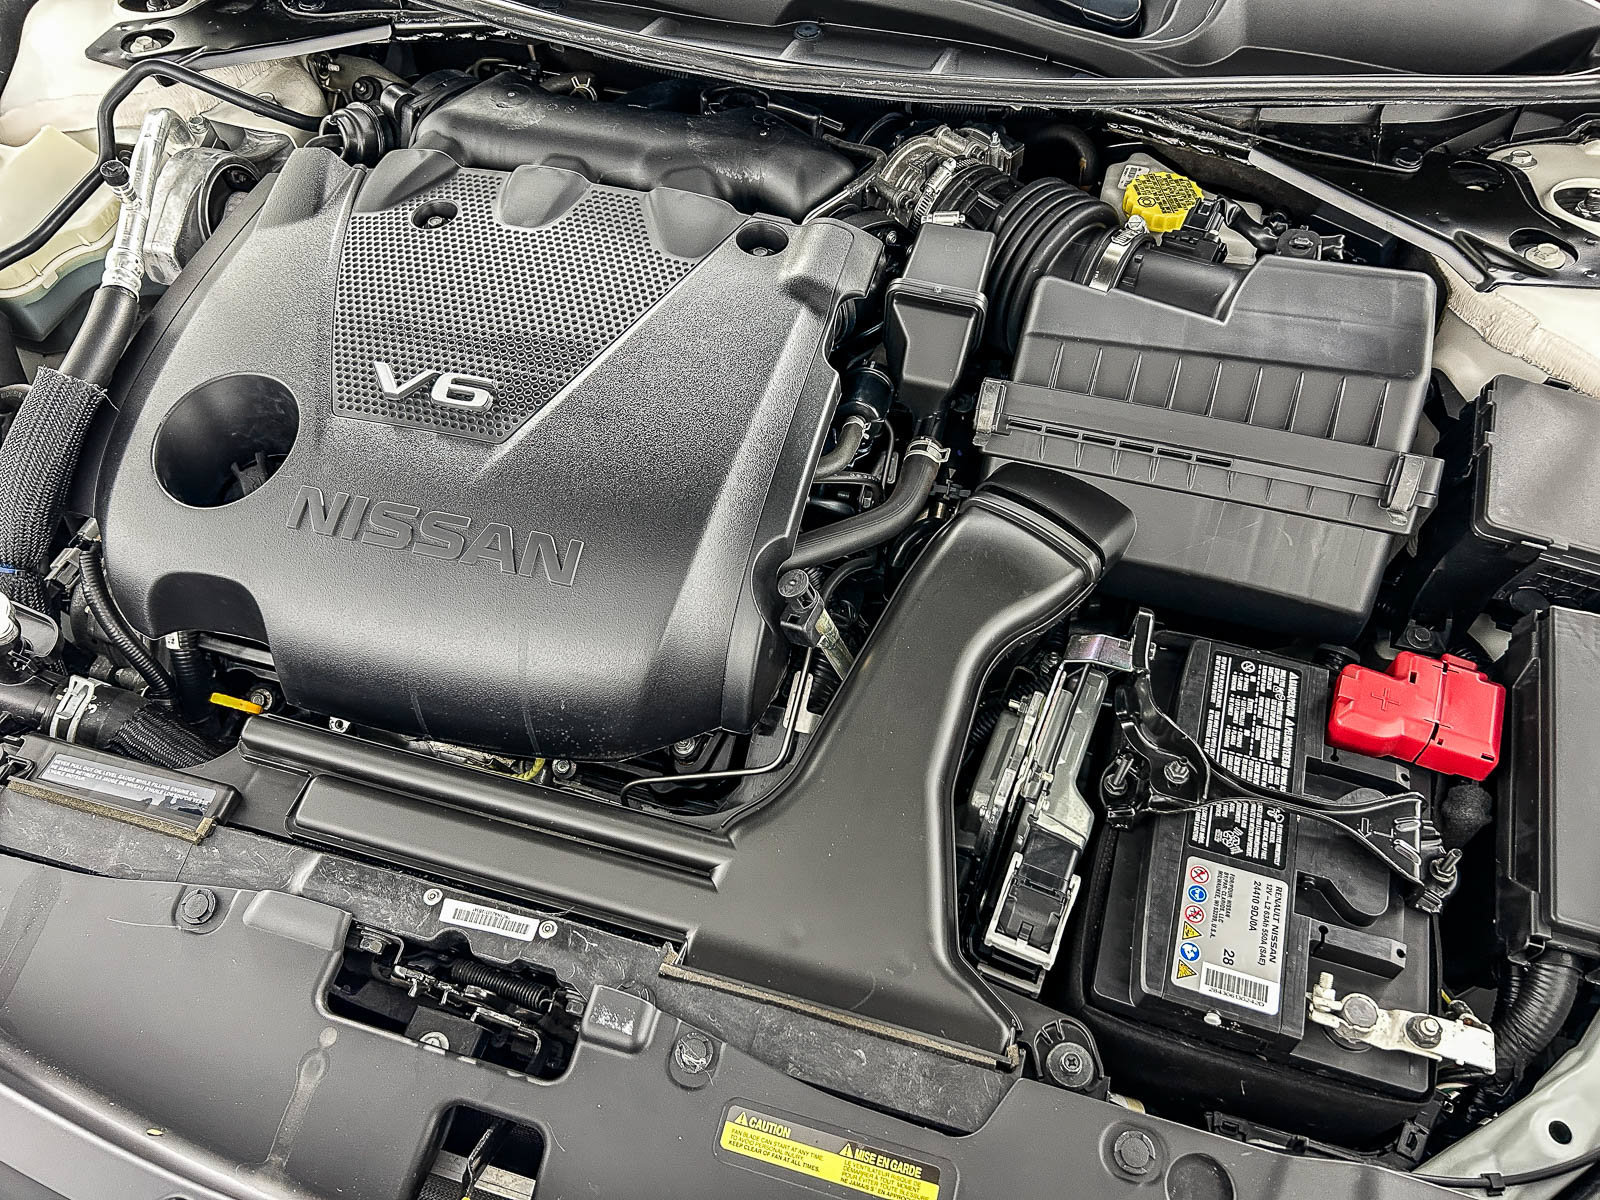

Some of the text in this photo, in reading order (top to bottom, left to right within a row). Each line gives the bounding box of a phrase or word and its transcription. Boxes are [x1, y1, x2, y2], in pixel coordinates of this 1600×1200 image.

[373, 361, 498, 414] V6
[286, 485, 585, 587] NISSAN
[1252, 880, 1262, 904] 24410
[1224, 899, 1232, 918] NISSAN
[1264, 901, 1271, 911] L2
[1262, 910, 1270, 928] 63Ah
[1268, 886, 1283, 964] RENAULT NISSAN
[1260, 928, 1268, 946] 550A
[1222, 948, 1235, 967] 28
[1258, 945, 1266, 967] (SAE)
[748, 1116, 792, 1139] CAUTION
[731, 1128, 742, 1136] FAN
[742, 1132, 760, 1141] BLADE
[760, 1137, 773, 1145] CAN
[773, 1141, 790, 1151] START
[798, 1149, 809, 1157] ANY
[738, 1137, 755, 1146] AVOID
[754, 1142, 784, 1155] PERSONAL
[728, 1140, 743, 1148] KEEP
[743, 1145, 762, 1154] CLEAR
[802, 1163, 820, 1172] TIMES.
[853, 1148, 923, 1179] MISE EN GARDE
[841, 1171, 858, 1181] POUR
[880, 1183, 897, 1192] TOUTE
[852, 1162, 890, 1178] VENTILATEUR
[891, 1174, 912, 1185] RISQUE
[880, 1176, 895, 1185] TOUT
[896, 1181, 920, 1193] MOMENT
[849, 1180, 869, 1190] JAMAIS
